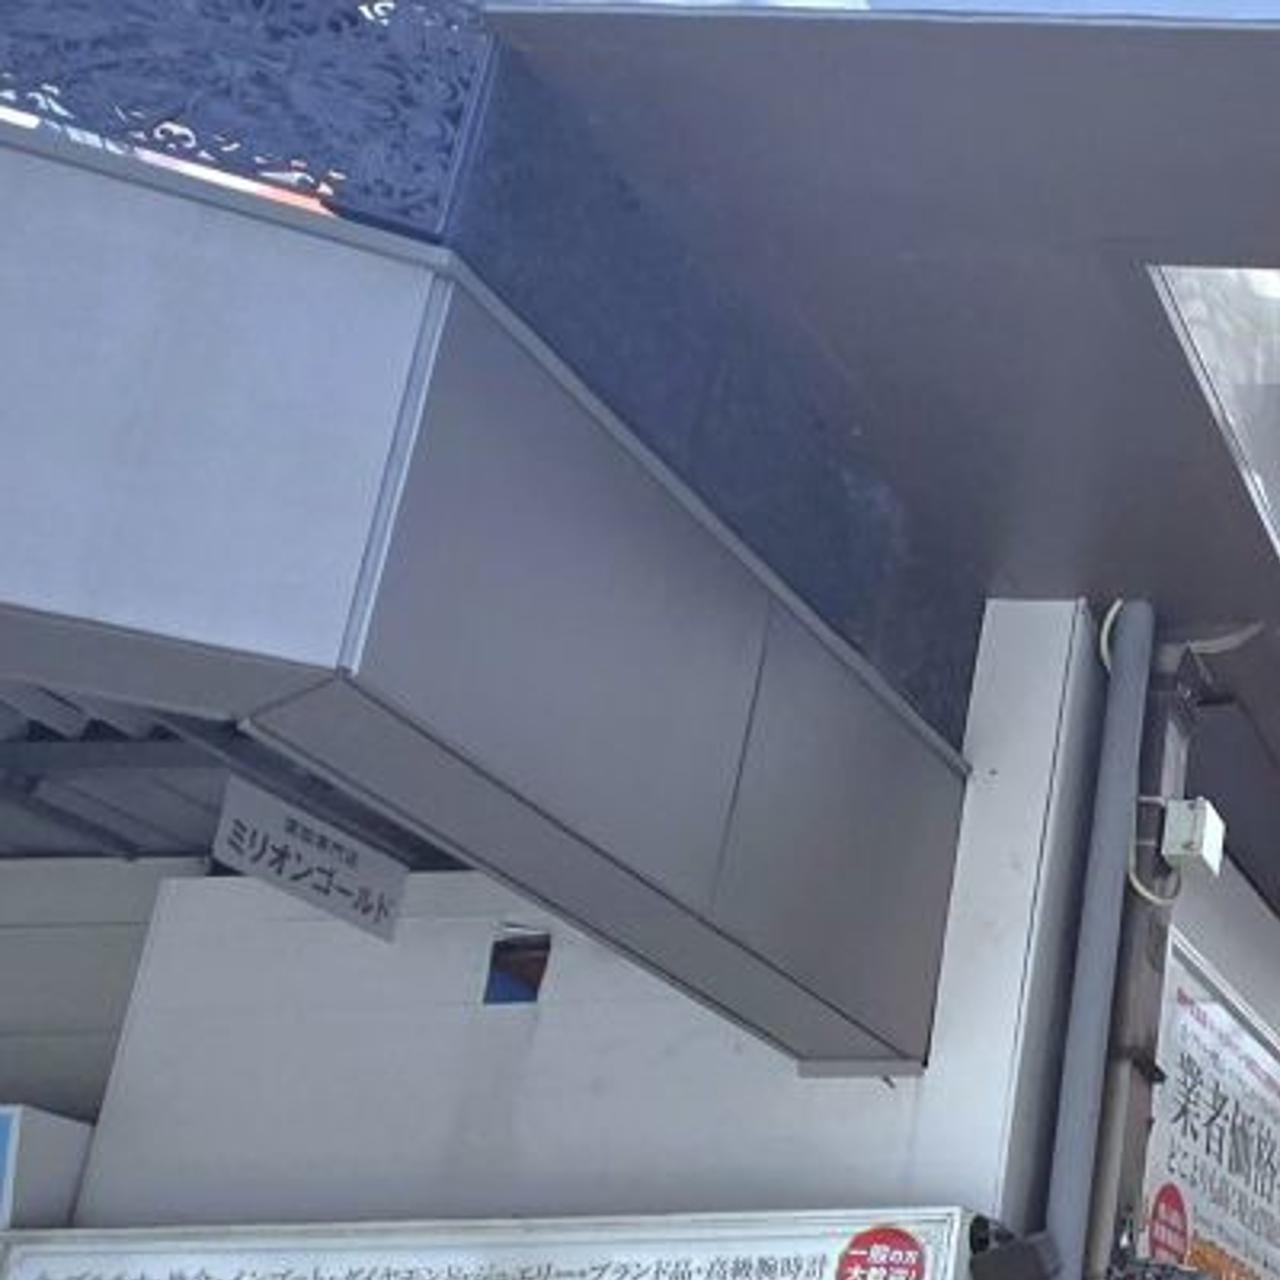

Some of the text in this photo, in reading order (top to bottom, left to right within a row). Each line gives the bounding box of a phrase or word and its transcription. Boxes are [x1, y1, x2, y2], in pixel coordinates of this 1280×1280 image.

[228, 818, 389, 923] ミリオンゴールド
[850, 1248, 918, 1266] 一般の方
